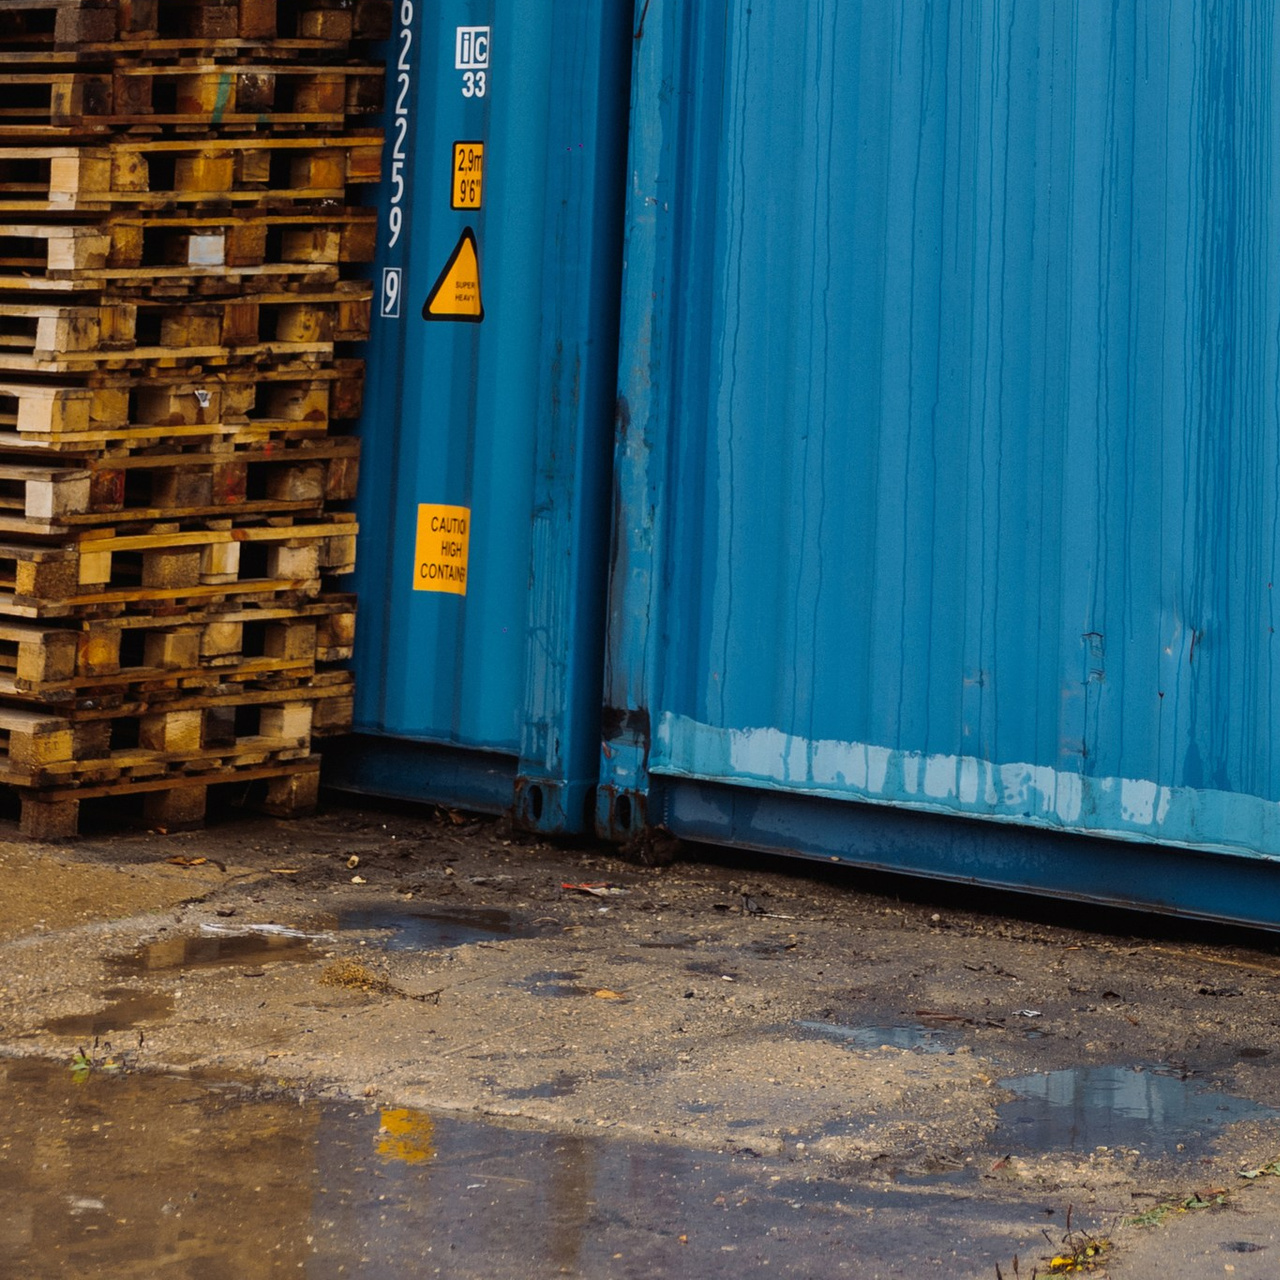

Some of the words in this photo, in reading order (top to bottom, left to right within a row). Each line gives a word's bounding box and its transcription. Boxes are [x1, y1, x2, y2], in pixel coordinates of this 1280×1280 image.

[461, 71, 486, 98] 33
[384, 270, 400, 313] 9
[455, 281, 476, 289] SUPER
[455, 294, 476, 302] HEAVY
[431, 516, 467, 536] CAUTIO
[441, 541, 462, 558] HIGH
[420, 563, 467, 584] CONTAINE
